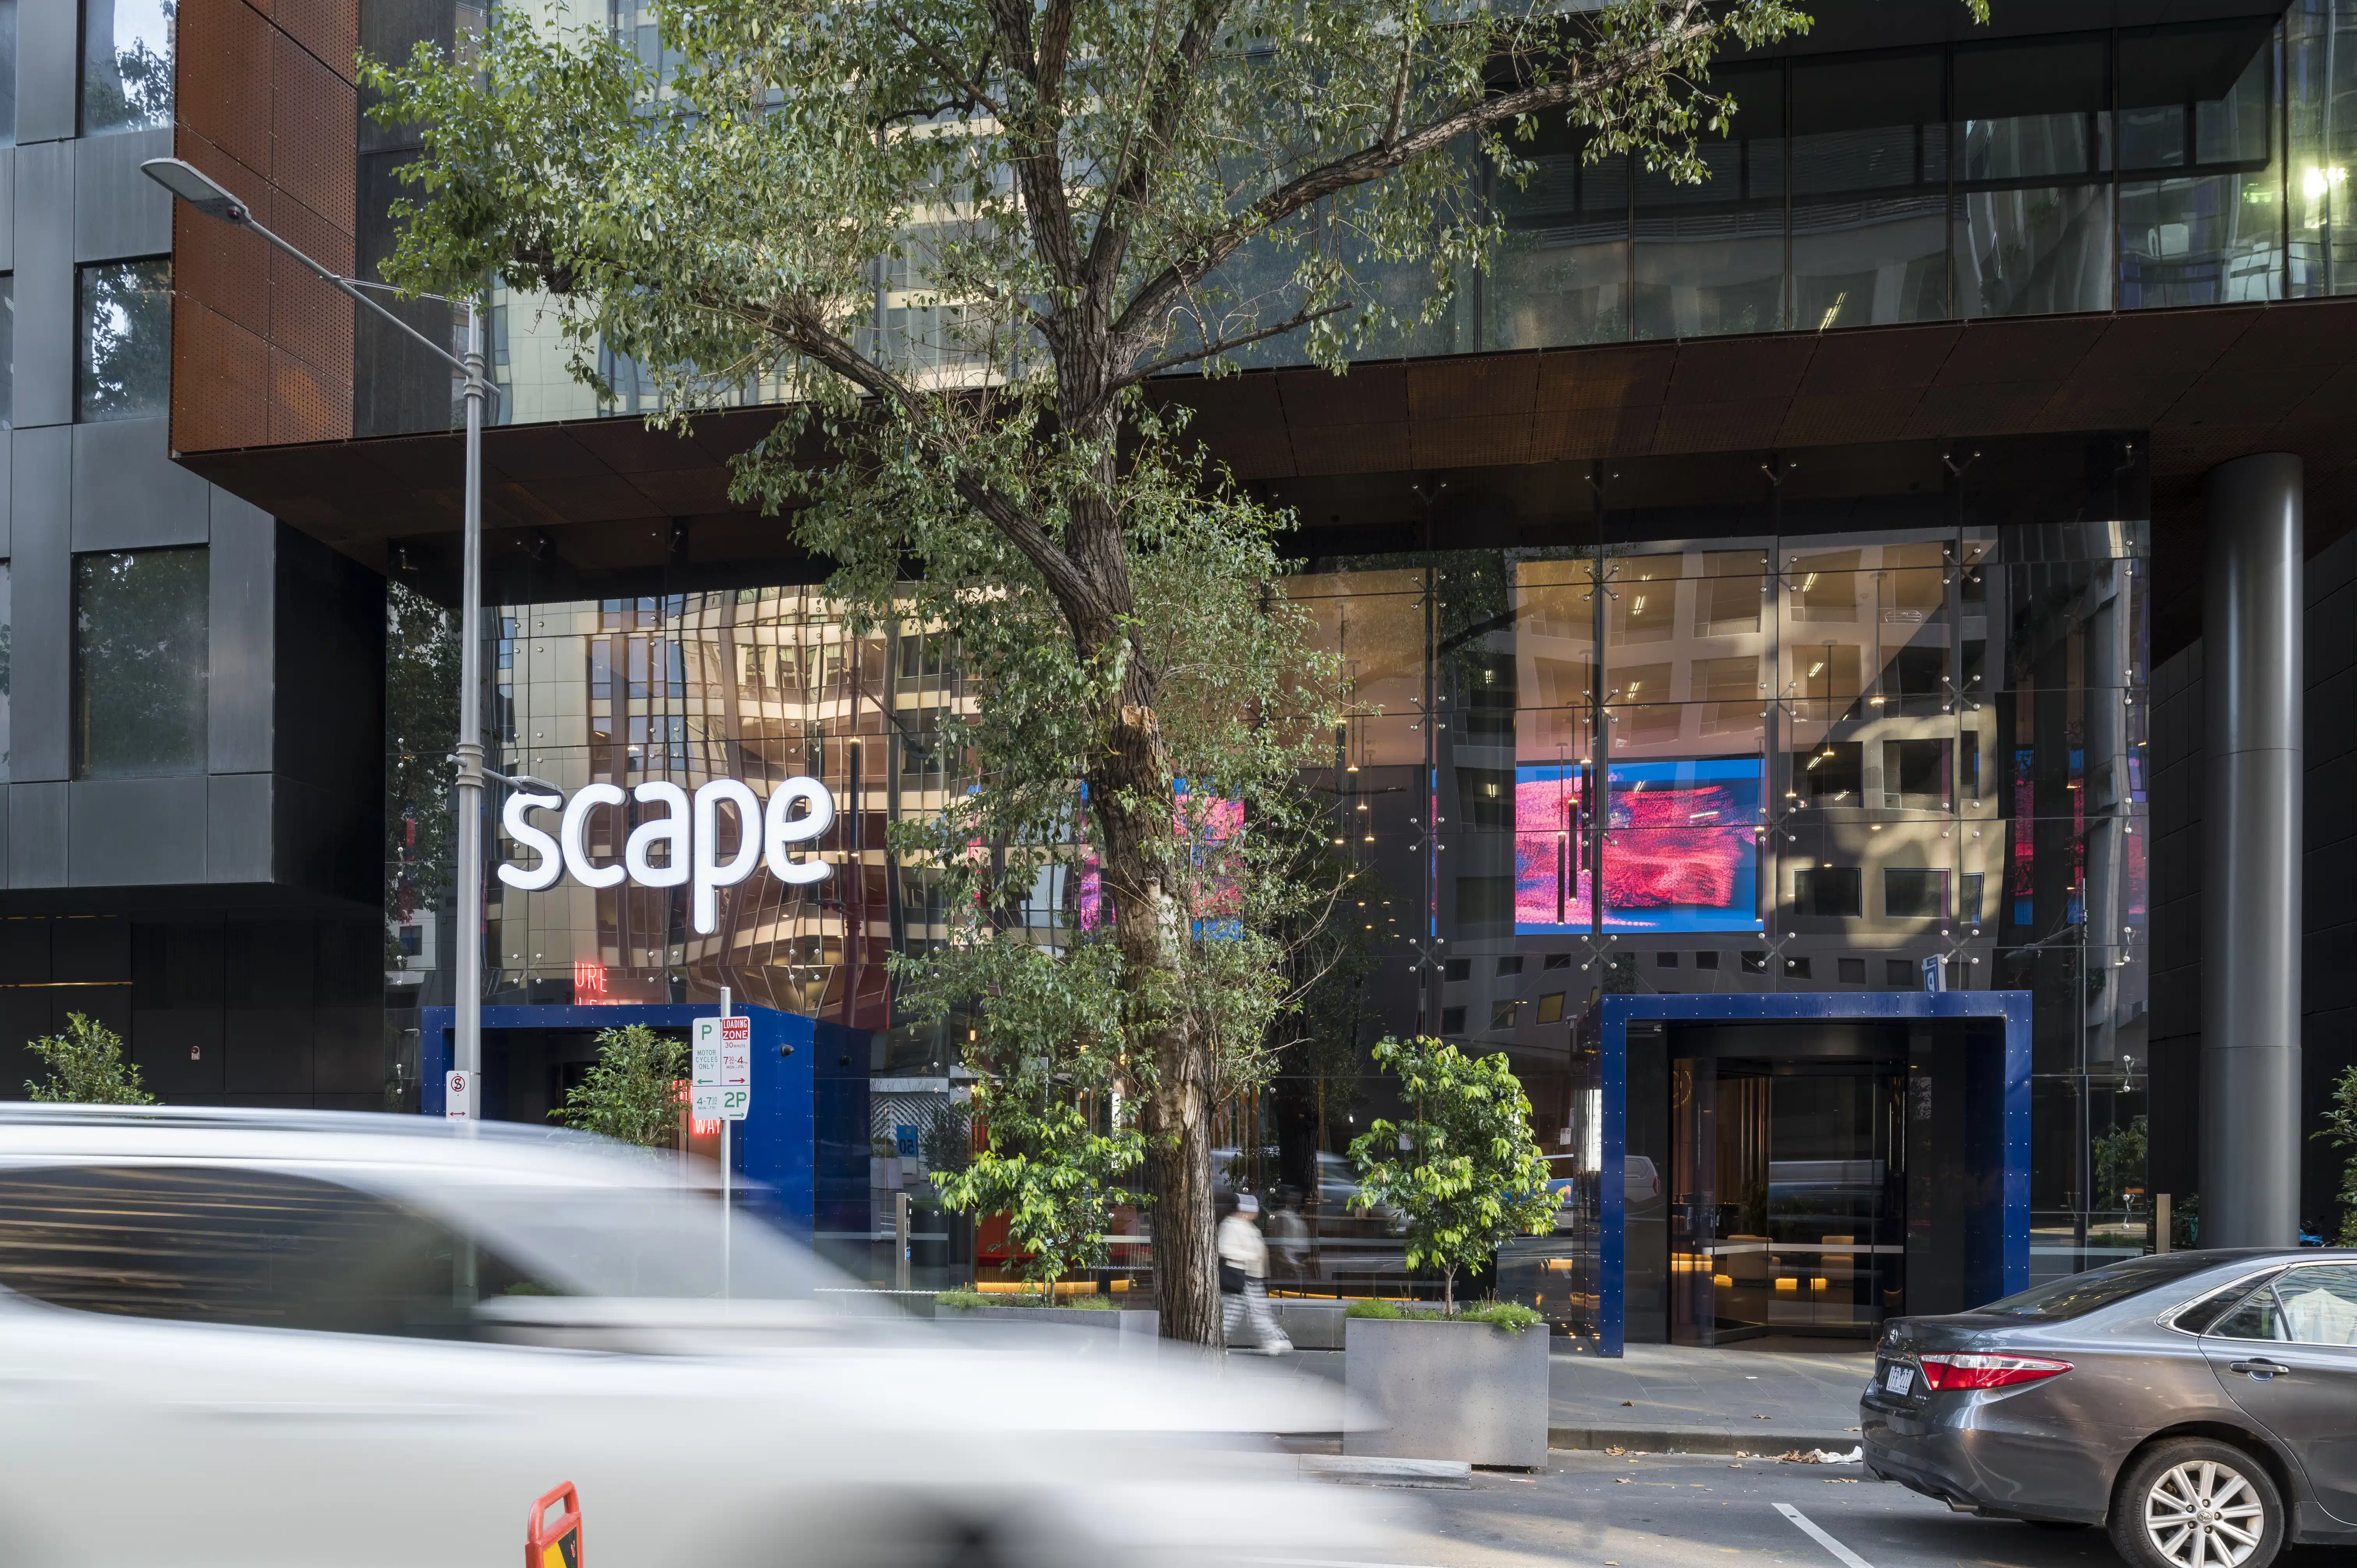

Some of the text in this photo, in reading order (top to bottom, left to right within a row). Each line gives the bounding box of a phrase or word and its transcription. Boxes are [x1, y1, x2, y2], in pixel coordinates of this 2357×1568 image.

[498, 776, 835, 935] scape
[701, 1024, 712, 1040] P
[723, 1019, 747, 1029] LOADING
[723, 1030, 747, 1039] ZONE
[724, 1091, 747, 1107] 2P
